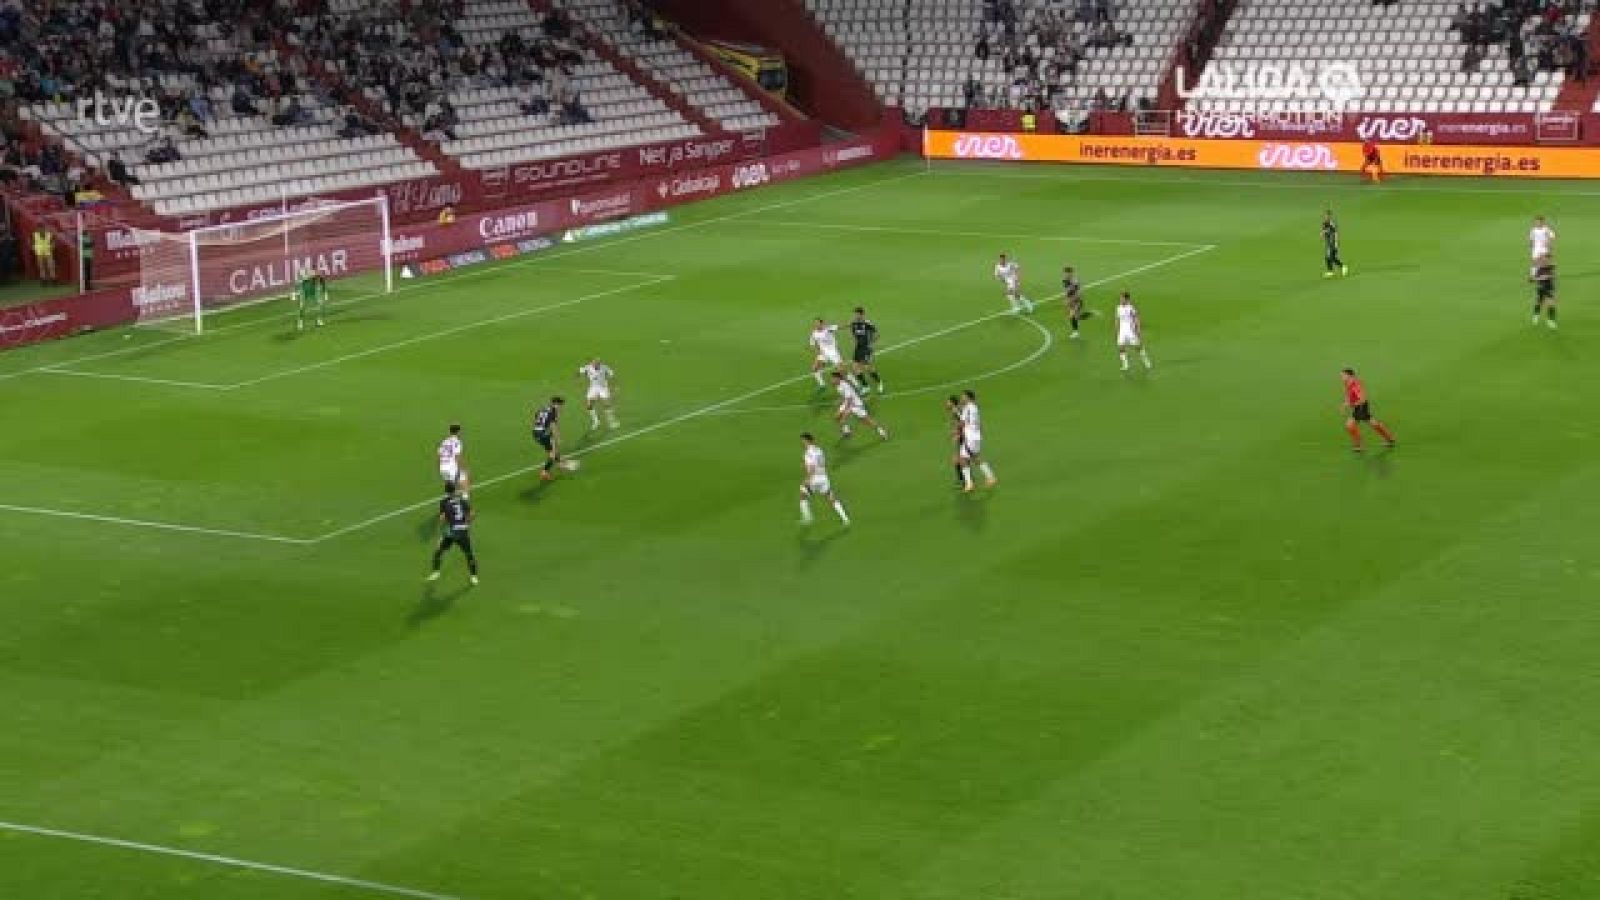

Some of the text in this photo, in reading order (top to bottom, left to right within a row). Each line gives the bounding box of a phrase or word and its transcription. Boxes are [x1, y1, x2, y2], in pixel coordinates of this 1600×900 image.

[1356, 116, 1427, 140] iner
[953, 132, 1022, 159] iner
[1079, 141, 1198, 164] inerenergia.es
[1258, 142, 1338, 169] iner
[1403, 151, 1542, 175] inerenergia.es
[479, 210, 539, 238] Canon
[229, 249, 349, 295] CALIMAR
